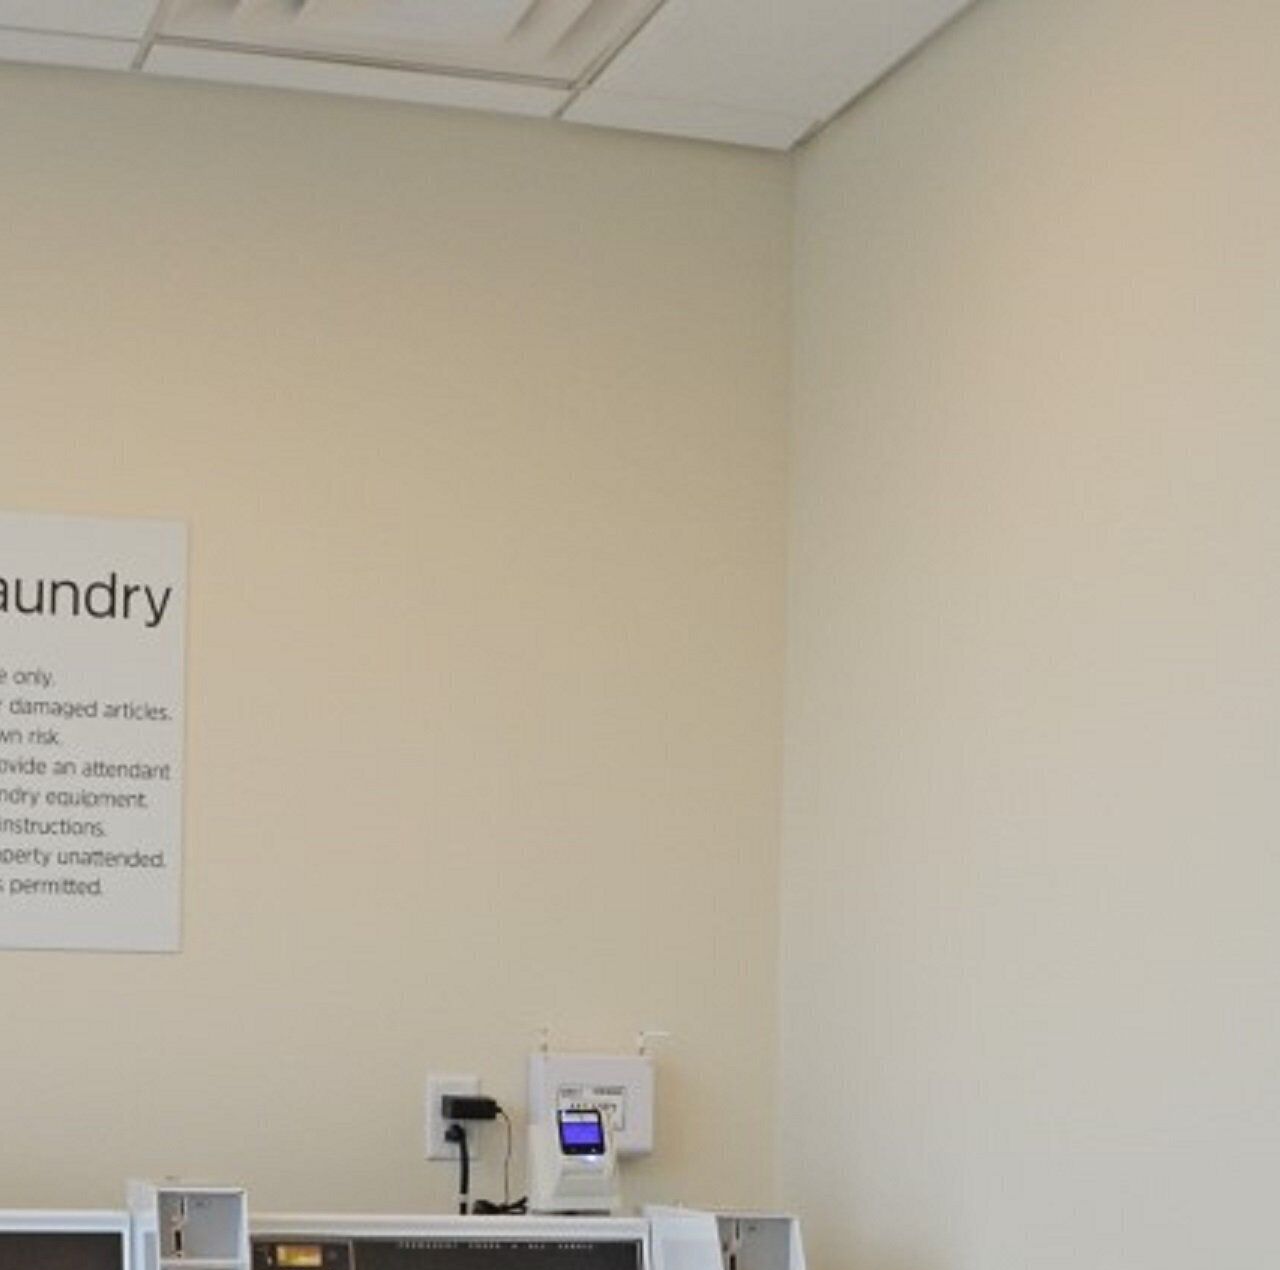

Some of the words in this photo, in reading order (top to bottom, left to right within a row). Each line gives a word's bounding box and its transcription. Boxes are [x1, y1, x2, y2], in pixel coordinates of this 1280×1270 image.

[12, 668, 56, 689] only.
[9, 698, 99, 719] damaged
[102, 701, 173, 721] articles.
[52, 760, 77, 775] an
[81, 759, 171, 779] attendant
[45, 788, 148, 808] equipment.
[57, 850, 167, 868] unattended.
